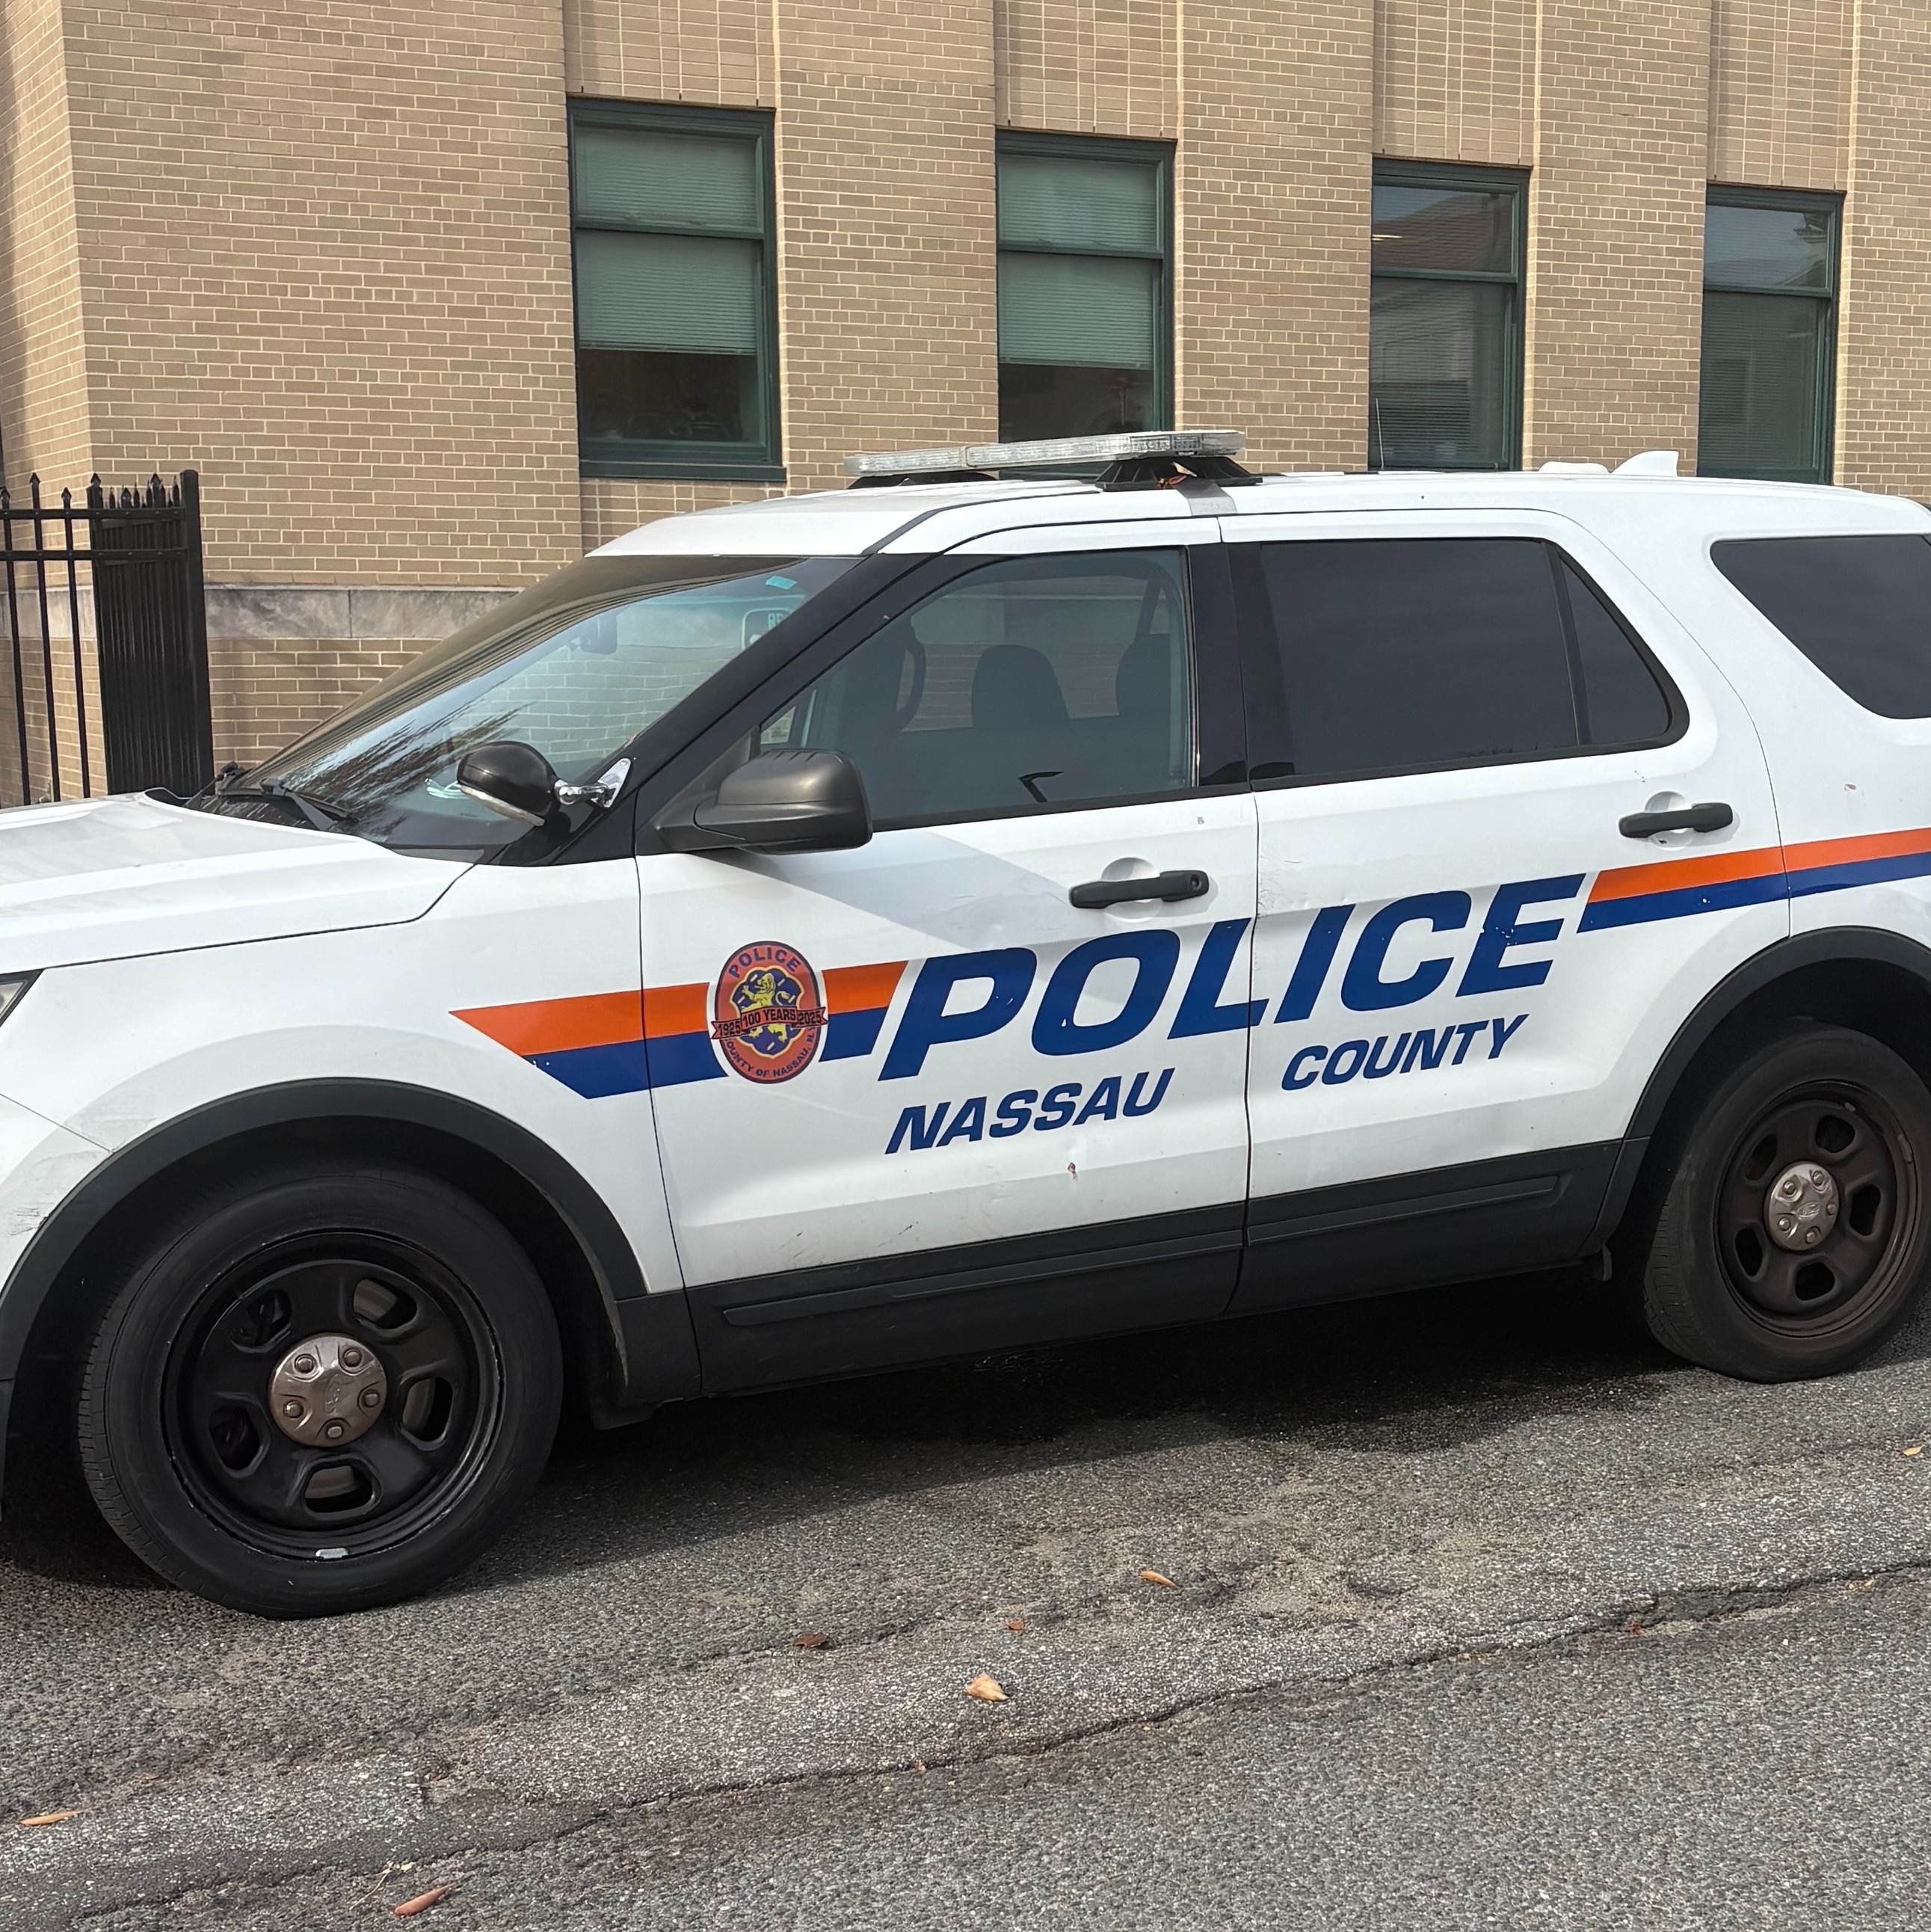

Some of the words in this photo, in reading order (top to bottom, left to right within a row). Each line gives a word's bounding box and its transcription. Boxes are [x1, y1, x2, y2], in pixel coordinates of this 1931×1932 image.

[728, 947, 801, 979] POLICE
[878, 873, 1586, 1081] POLICE
[718, 1021, 741, 1036] 1925
[743, 1012, 761, 1027] 100
[764, 1008, 796, 1022] YEARS
[799, 1012, 822, 1026] 2025
[755, 1069, 770, 1077] OF
[1281, 1014, 1528, 1091] COUNTY
[885, 1067, 1175, 1154] NASSAU
